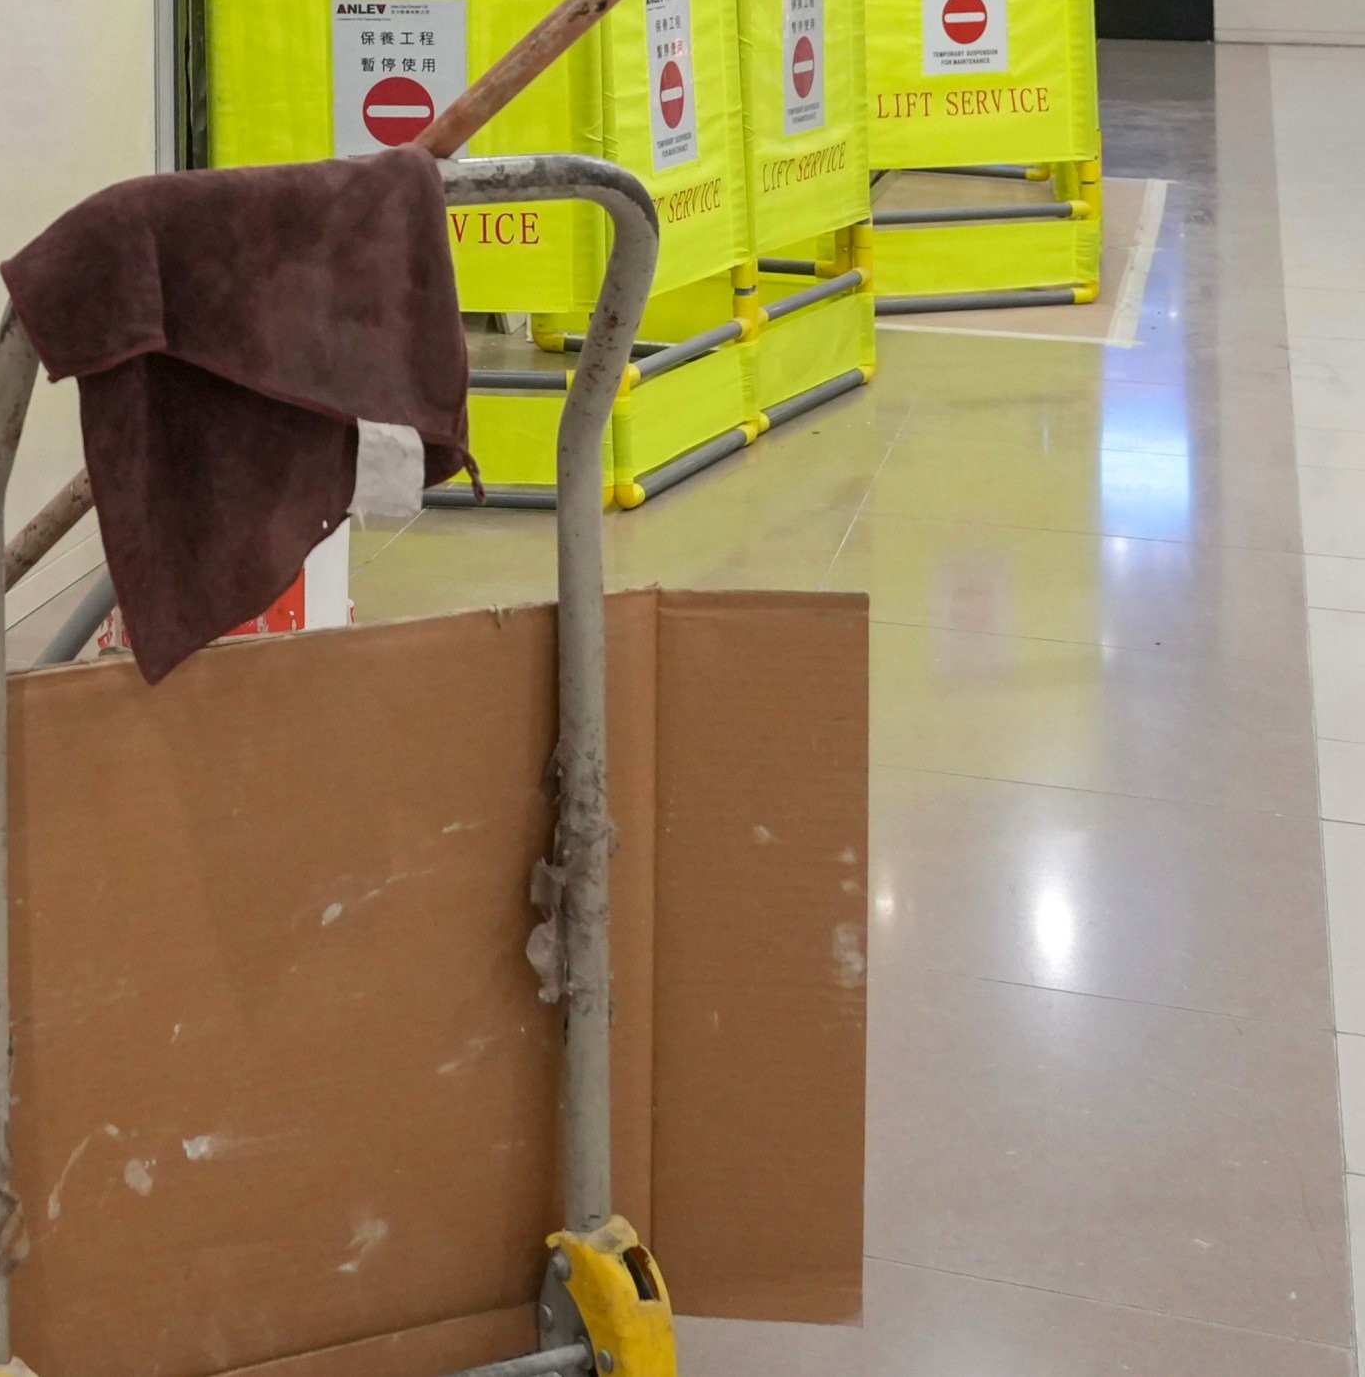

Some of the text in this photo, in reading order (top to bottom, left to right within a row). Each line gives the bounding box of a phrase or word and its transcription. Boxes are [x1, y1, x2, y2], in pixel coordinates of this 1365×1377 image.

[336, 4, 386, 15] ANLEV
[361, 31, 435, 46] 保養工程
[361, 57, 436, 73] 暫停使用
[877, 87, 1050, 119] LIFT SERVICE
[763, 141, 846, 193] LIFT SERVICE
[668, 178, 721, 223] SERVICE
[450, 212, 540, 244] VICE
